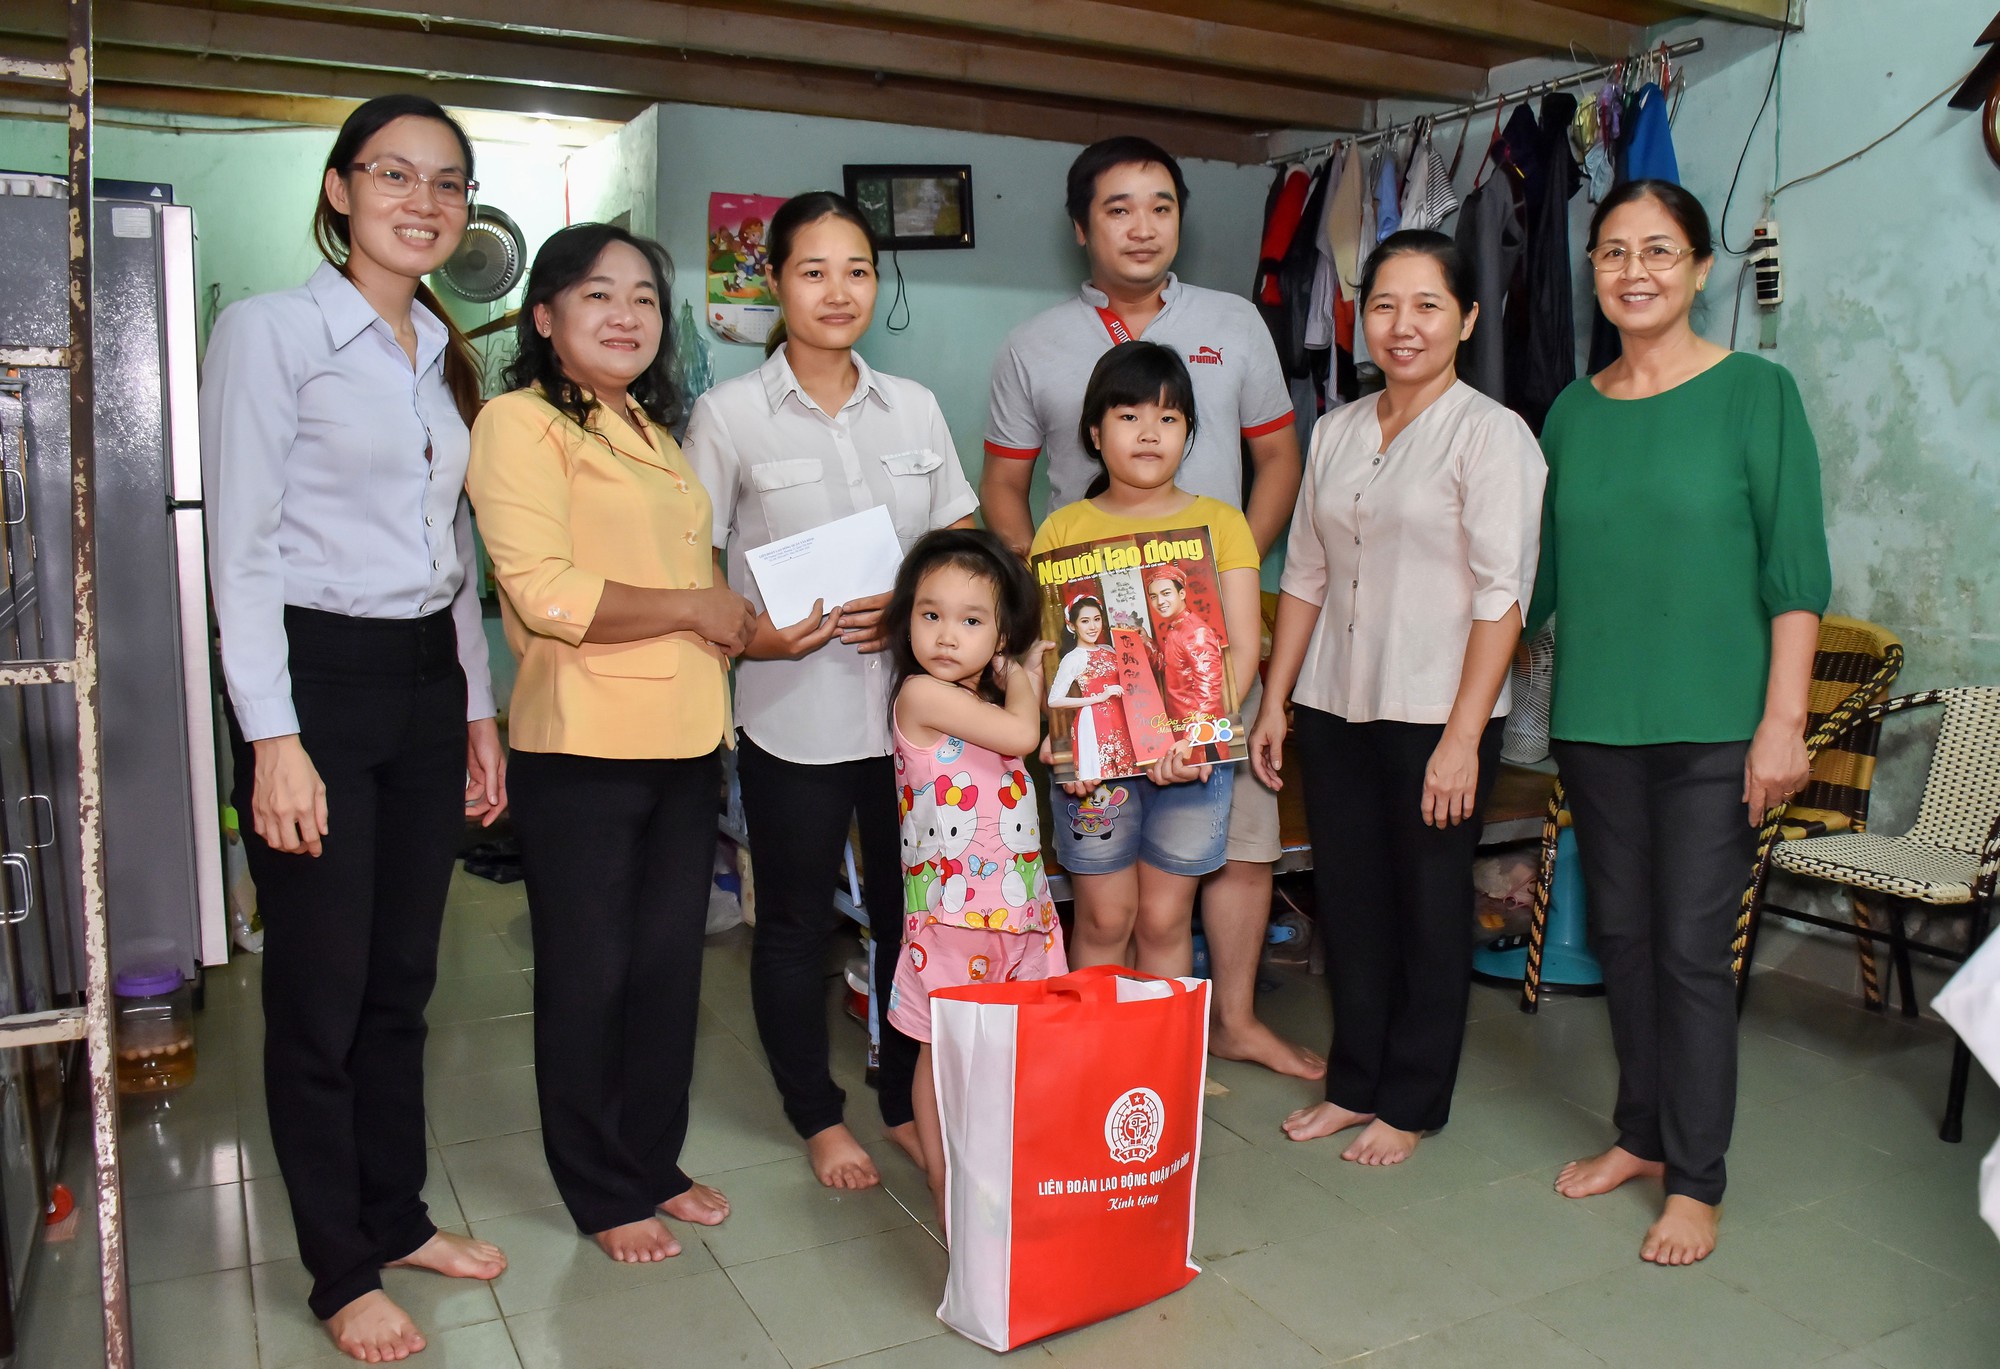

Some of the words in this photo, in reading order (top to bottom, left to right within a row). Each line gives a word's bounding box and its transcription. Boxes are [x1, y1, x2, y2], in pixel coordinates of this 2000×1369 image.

[1189, 355, 1218, 365] PUMA
[1037, 549, 1103, 586] Người
[1104, 546, 1142, 571] lao
[1185, 717, 1234, 748] 2018
[1123, 1149, 1146, 1159] TLĐ
[1038, 1178, 1063, 1196] LIÊN
[1066, 1176, 1097, 1194] ĐOÀN
[1100, 1176, 1118, 1192] LAO
[1121, 1171, 1148, 1191] ĐỘNG
[1149, 1165, 1170, 1186] QUẬN
[1107, 1195, 1135, 1212] Kính
[1137, 1194, 1160, 1208] tặng
